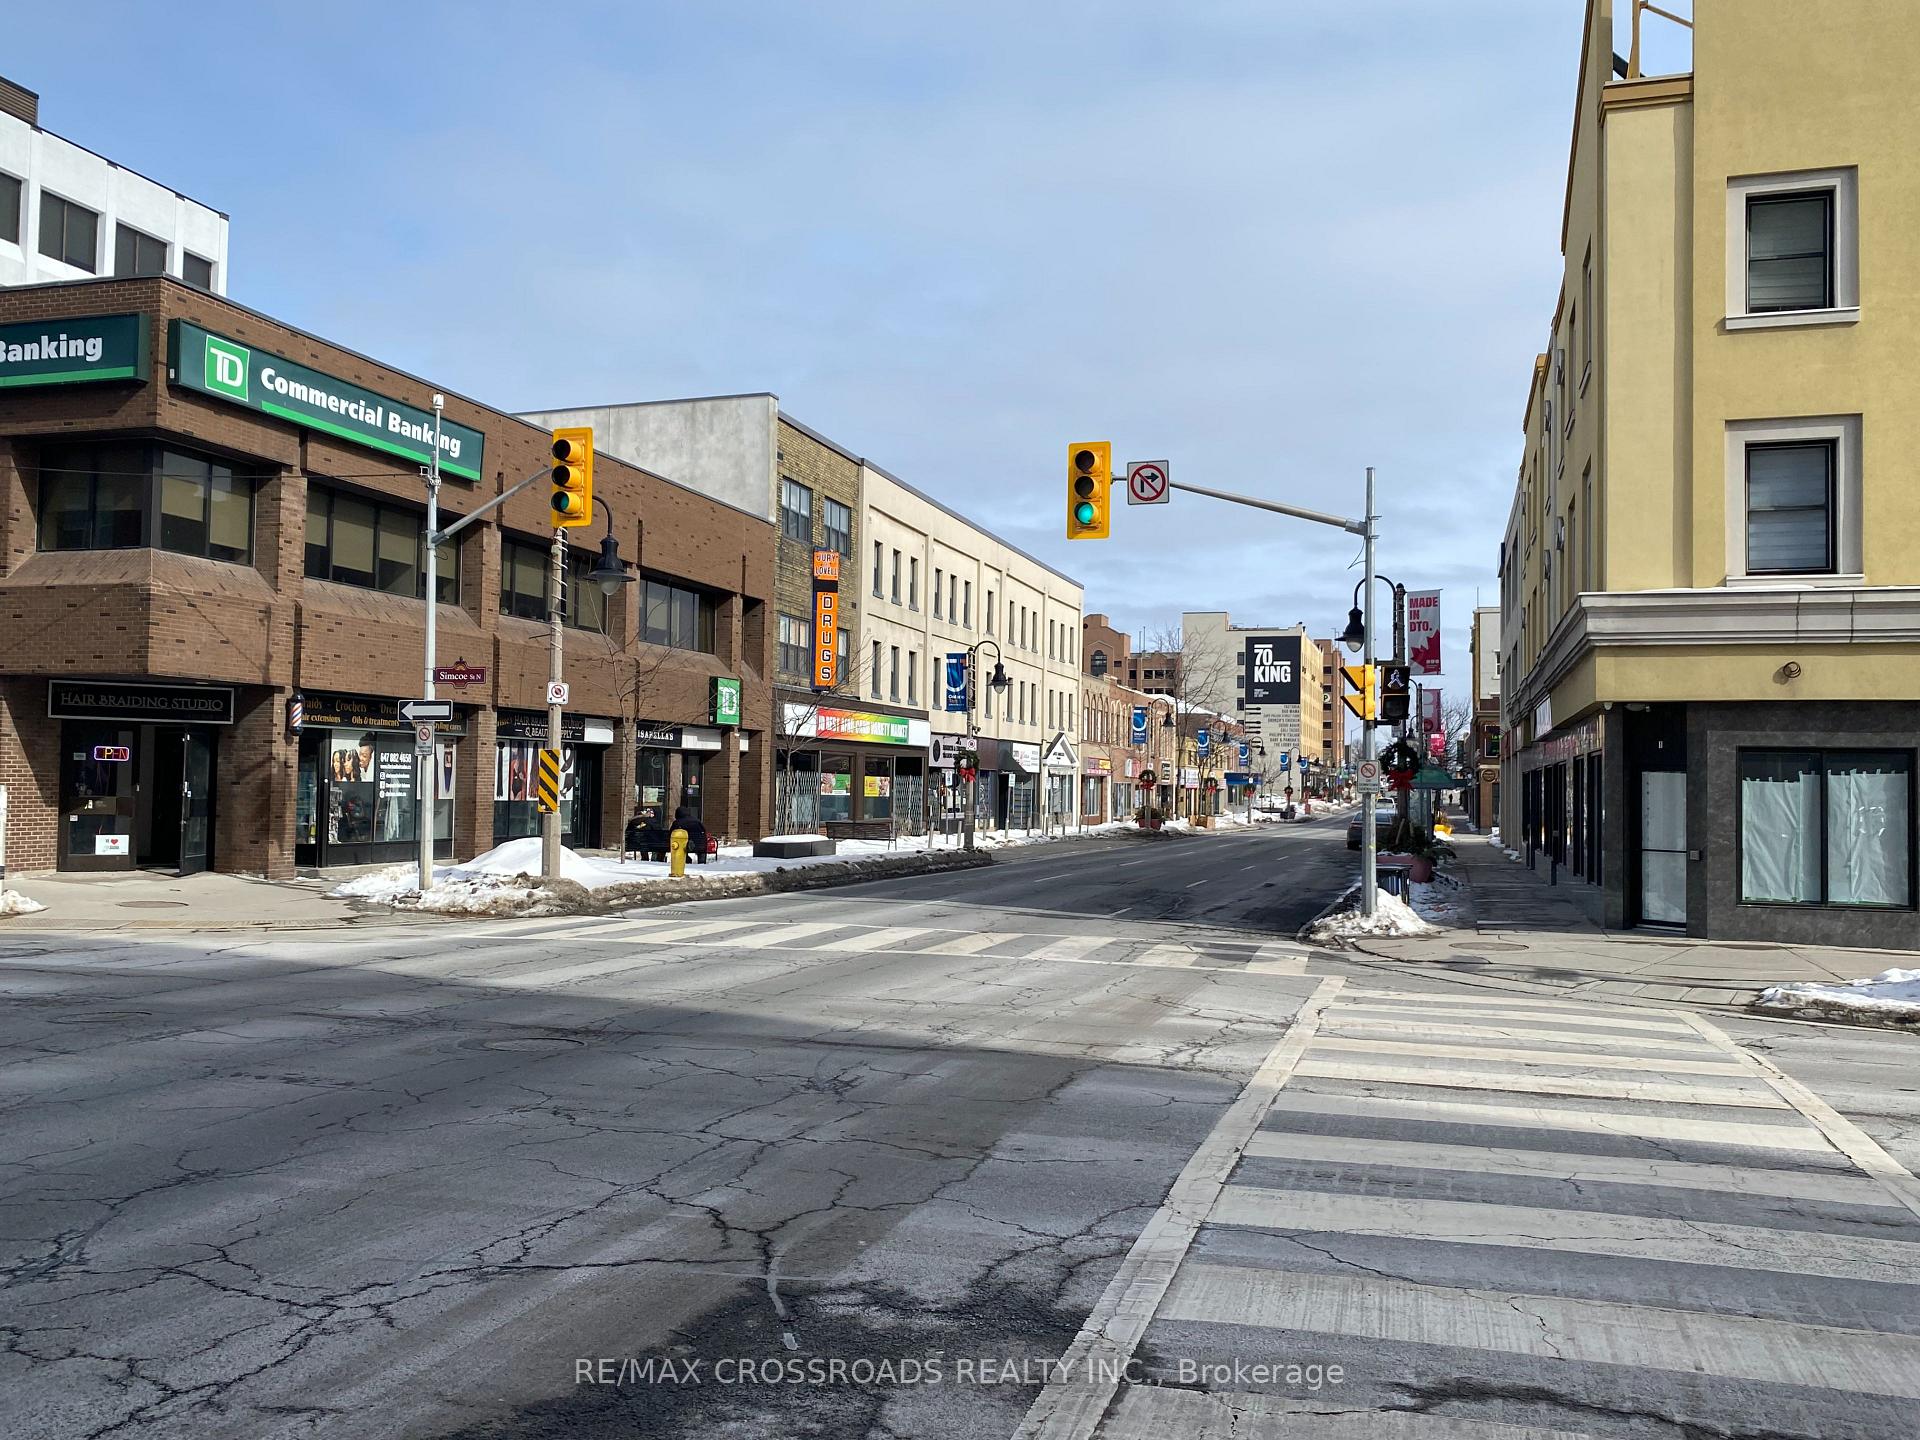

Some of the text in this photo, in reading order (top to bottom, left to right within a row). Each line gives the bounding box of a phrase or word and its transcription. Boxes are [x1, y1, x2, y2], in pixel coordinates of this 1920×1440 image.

[210, 346, 244, 387] TD
[260, 367, 382, 428] Commercial
[816, 553, 835, 562] JURY
[1409, 597, 1438, 608] MADE
[1409, 610, 1420, 620] IN
[1409, 621, 1433, 632] DTO.
[820, 595, 833, 680] DRUGS
[1254, 648, 1273, 666] 70
[439, 671, 468, 680] Simcoe
[1254, 665, 1291, 683] KING
[60, 692, 224, 711] HAIR BRAIDING STUDIO
[302, 699, 322, 710] raids
[311, 713, 341, 723] extensions
[369, 716, 399, 727] treatments
[533, 727, 548, 738] BEAUT
